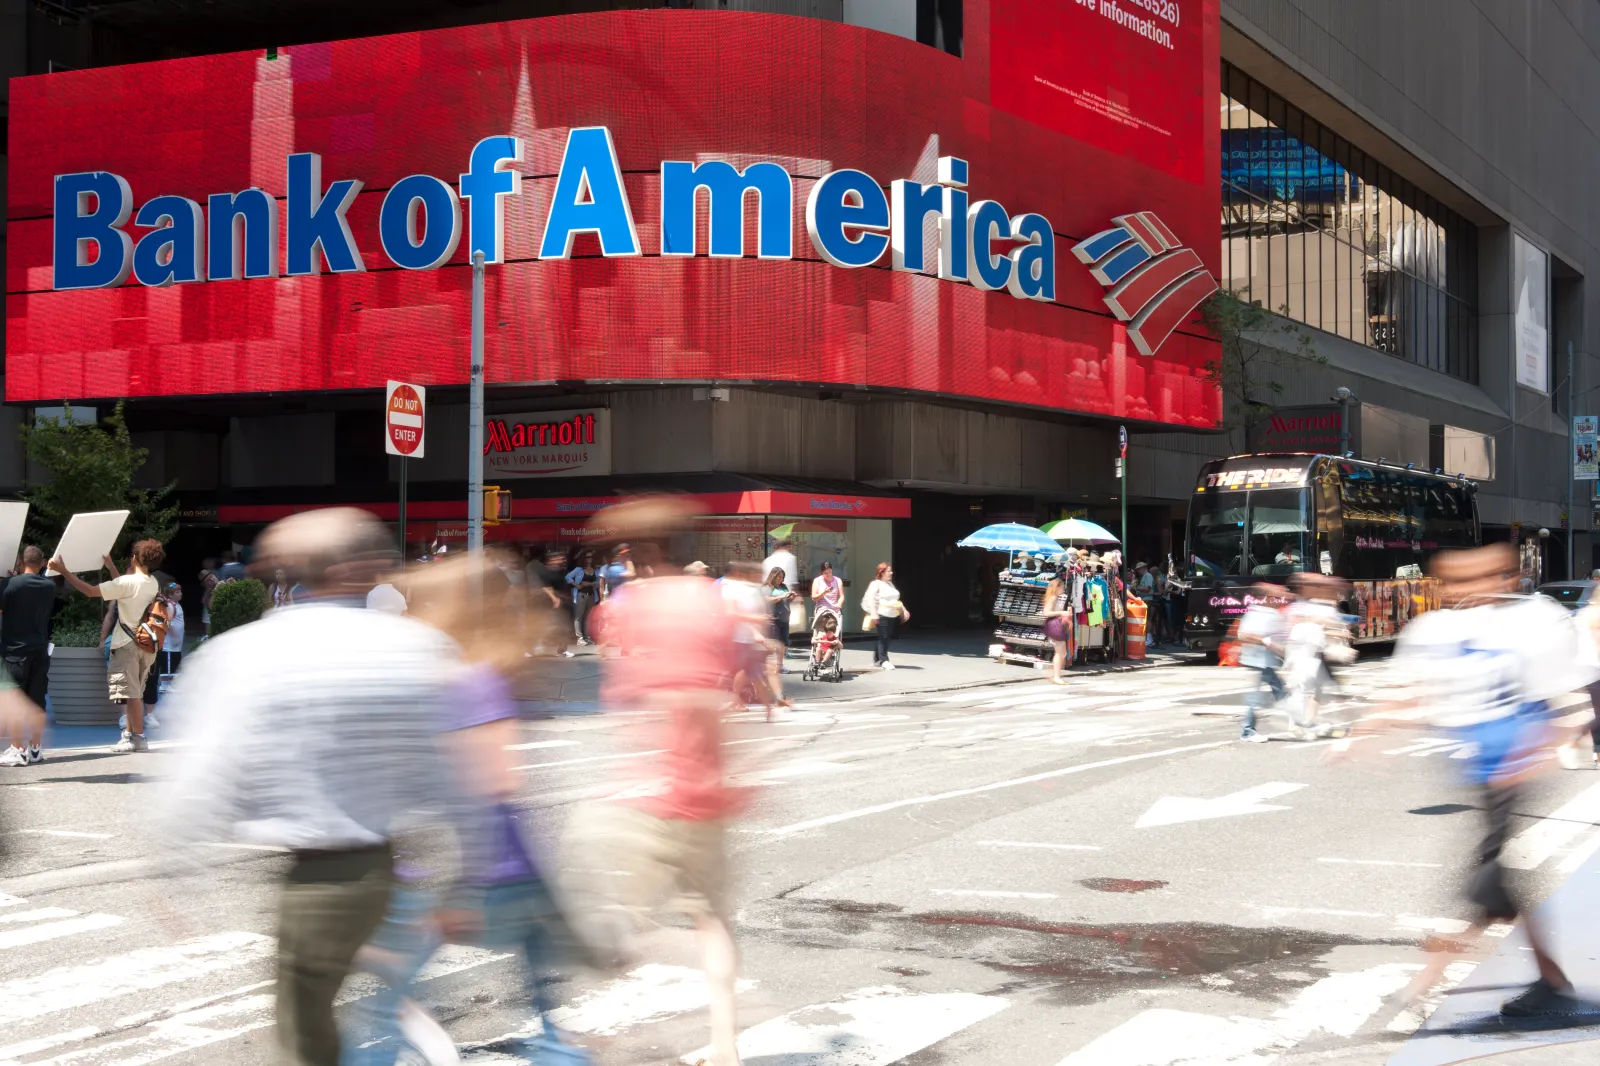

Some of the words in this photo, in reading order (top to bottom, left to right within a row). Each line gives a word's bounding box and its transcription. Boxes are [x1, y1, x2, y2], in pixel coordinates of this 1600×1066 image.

[53, 151, 366, 291] Bank
[379, 134, 524, 270] of
[538, 125, 1056, 302] America
[393, 397, 403, 408] DO
[405, 399, 418, 411] NOT
[395, 428, 416, 442] ENTER
[483, 413, 596, 455] Marriott
[489, 456, 508, 466] NEW
[511, 455, 538, 466] YORK
[541, 453, 588, 464] MARQUIS
[1210, 596, 1225, 607] Get
